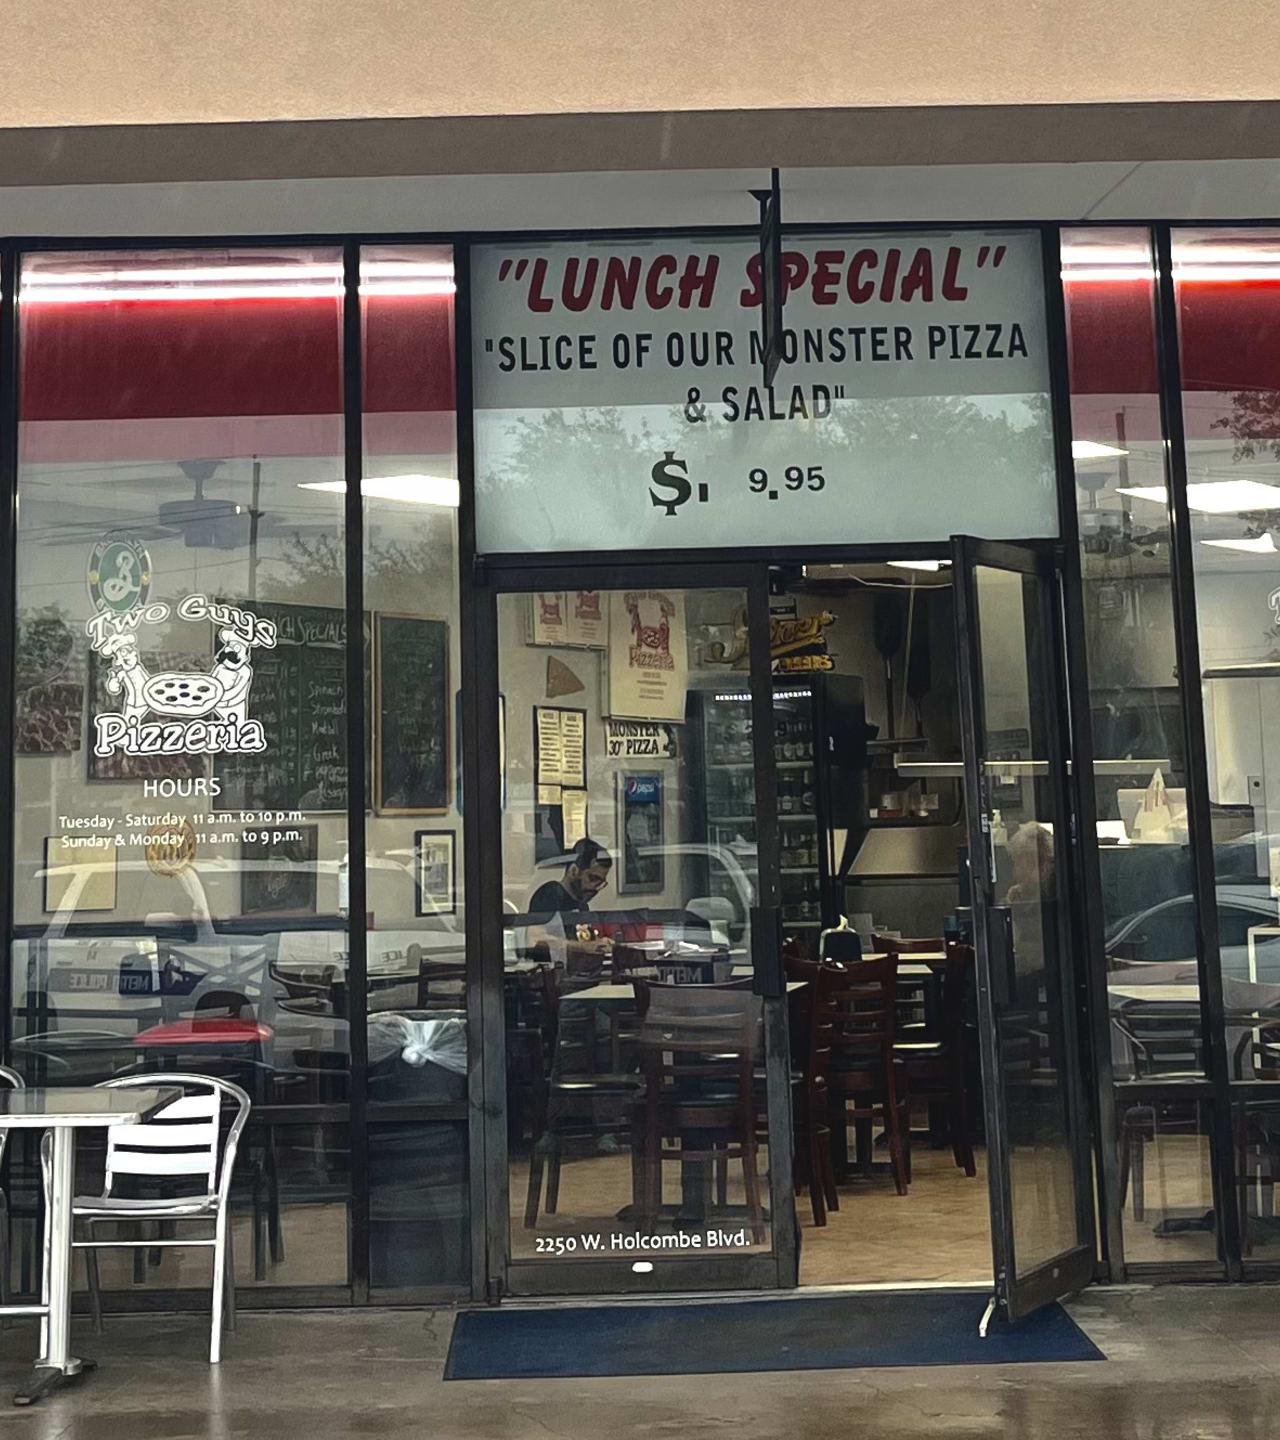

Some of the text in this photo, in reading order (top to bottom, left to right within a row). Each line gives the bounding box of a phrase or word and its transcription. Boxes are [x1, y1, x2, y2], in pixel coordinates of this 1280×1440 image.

[613, 333, 653, 369] OF
[667, 331, 734, 367] OUR
[928, 323, 1029, 361] PIZZA
[684, 387, 706, 423] &
[87, 602, 170, 651] Two
[177, 594, 276, 649] Guys
[94, 712, 267, 757] Pizzeria
[609, 722, 660, 738] MONSTER
[627, 738, 659, 755] PIZZA
[143, 778, 221, 798] HOURS
[59, 815, 114, 831] Tuesday
[126, 813, 186, 828] Saturday
[193, 814, 204, 824] 11
[208, 812, 237, 824] a.m.
[240, 812, 254, 823] to
[258, 812, 271, 822] 10
[276, 812, 306, 826] p.m.
[61, 830, 303, 850] Sunday & Monday 11 a.m. to 9 p.m.
[535, 1229, 750, 1255] 2250 W. Holcombe Blvd.
